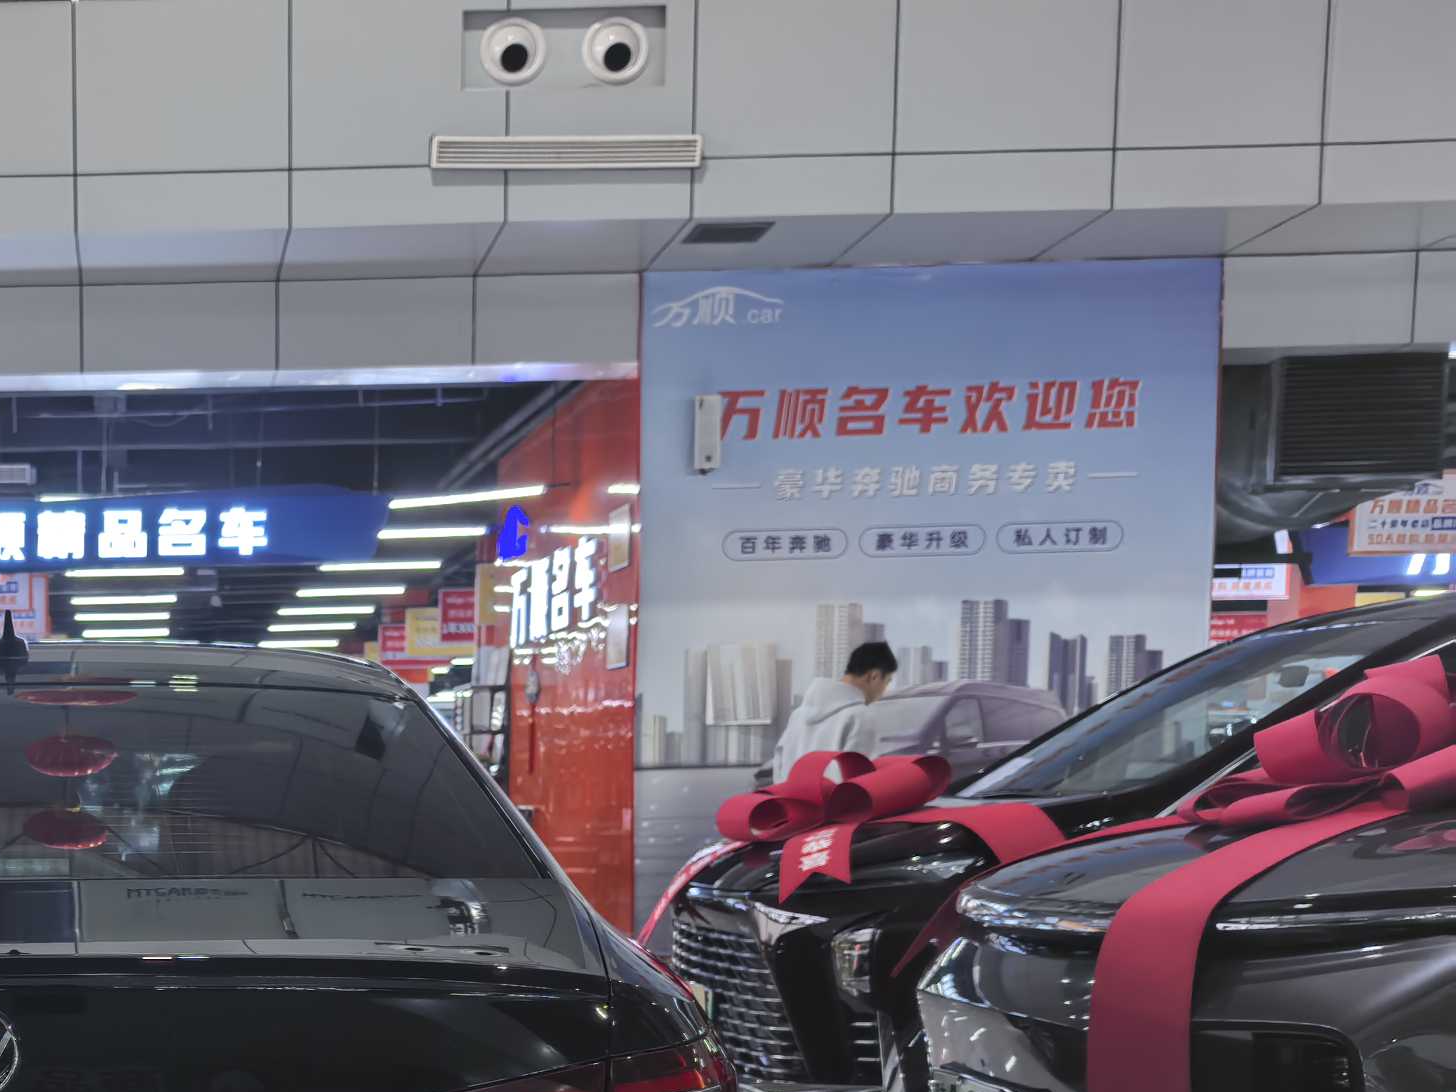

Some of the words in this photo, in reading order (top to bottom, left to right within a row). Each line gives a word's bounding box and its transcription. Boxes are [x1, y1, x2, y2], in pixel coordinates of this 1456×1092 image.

[747, 307, 783, 324] car
[718, 376, 1141, 441] 万顺名车欢迎您
[774, 461, 1076, 500] 豪华奔驰商务专卖
[739, 534, 831, 555] 百年奔驰
[875, 530, 969, 551] 豪华升级
[1014, 526, 1108, 547] 私人订制
